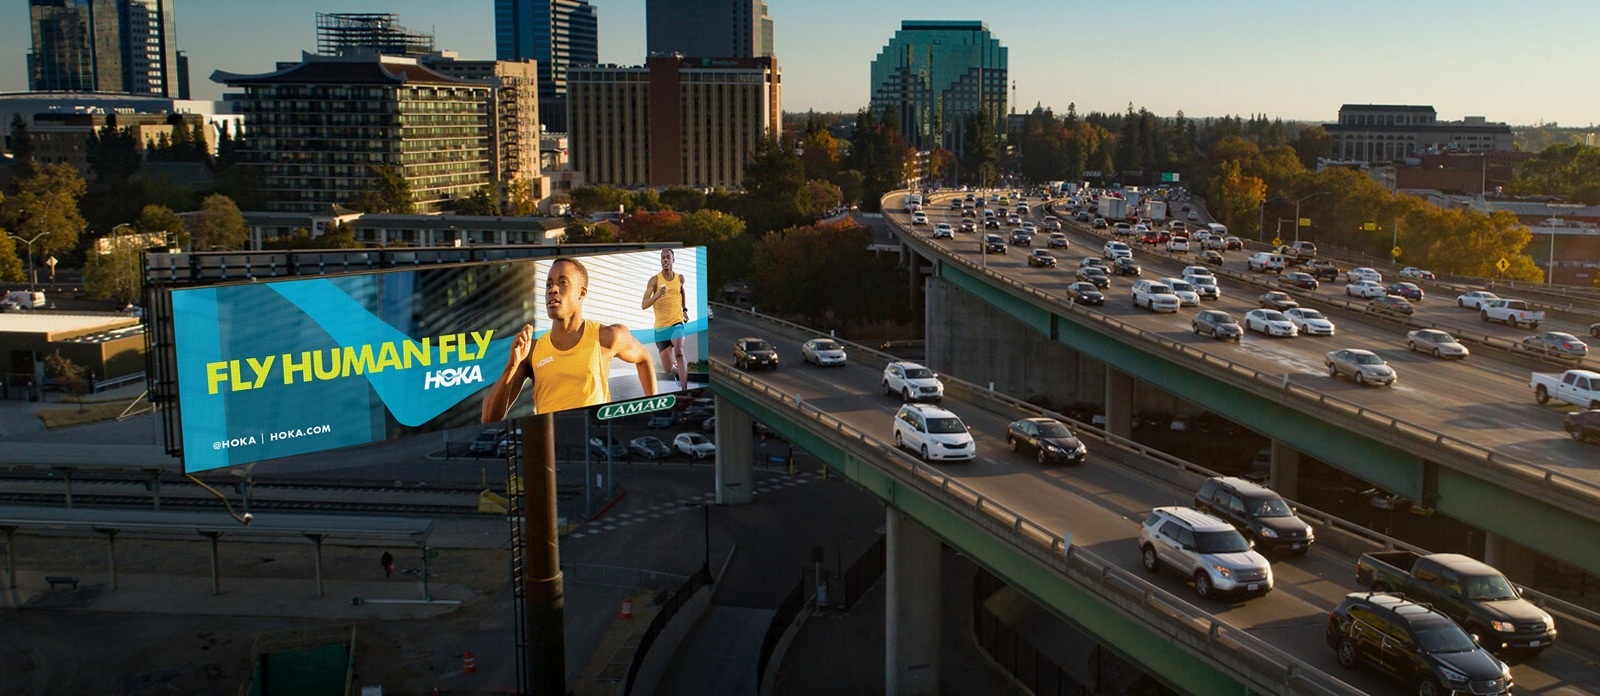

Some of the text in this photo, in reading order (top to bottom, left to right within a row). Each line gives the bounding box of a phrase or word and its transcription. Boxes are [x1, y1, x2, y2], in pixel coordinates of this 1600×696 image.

[206, 329, 495, 395] FLY HUMAN FLY
[424, 364, 483, 390] HOKA
[604, 398, 668, 418] LAMAR
[212, 436, 257, 450] @HOKA
[270, 424, 331, 442] HOKA.COM
